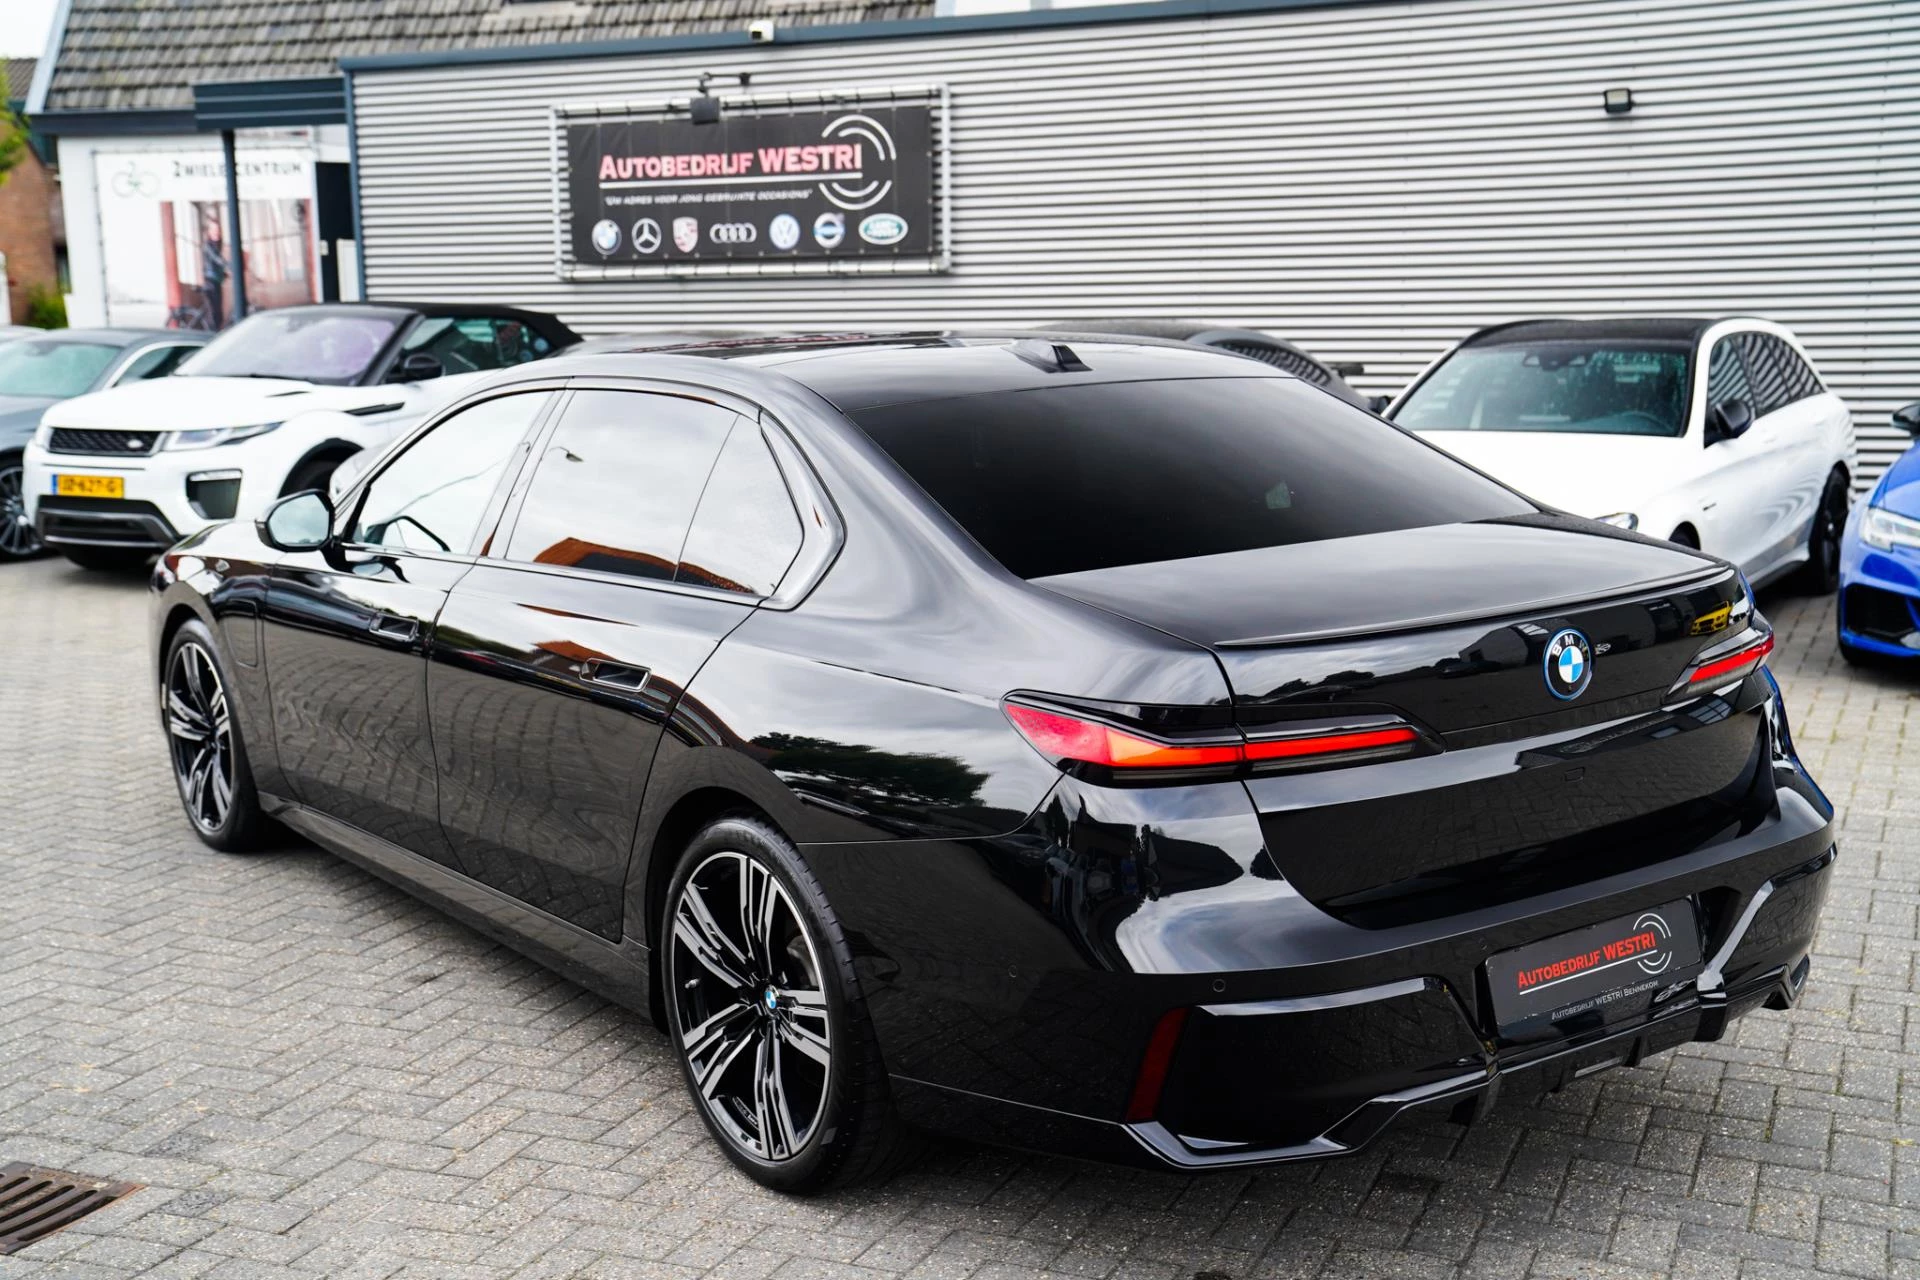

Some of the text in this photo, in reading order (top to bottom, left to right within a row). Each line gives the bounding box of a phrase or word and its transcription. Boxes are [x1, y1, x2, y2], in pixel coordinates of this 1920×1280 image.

[598, 144, 863, 180] AUTOBEDRIJF WESTRI
[1517, 931, 1657, 989] AUTOBEDRIJF WESTRI
[1595, 991, 1623, 1005] WESTRI
[1624, 980, 1659, 996] BENNEKOM
